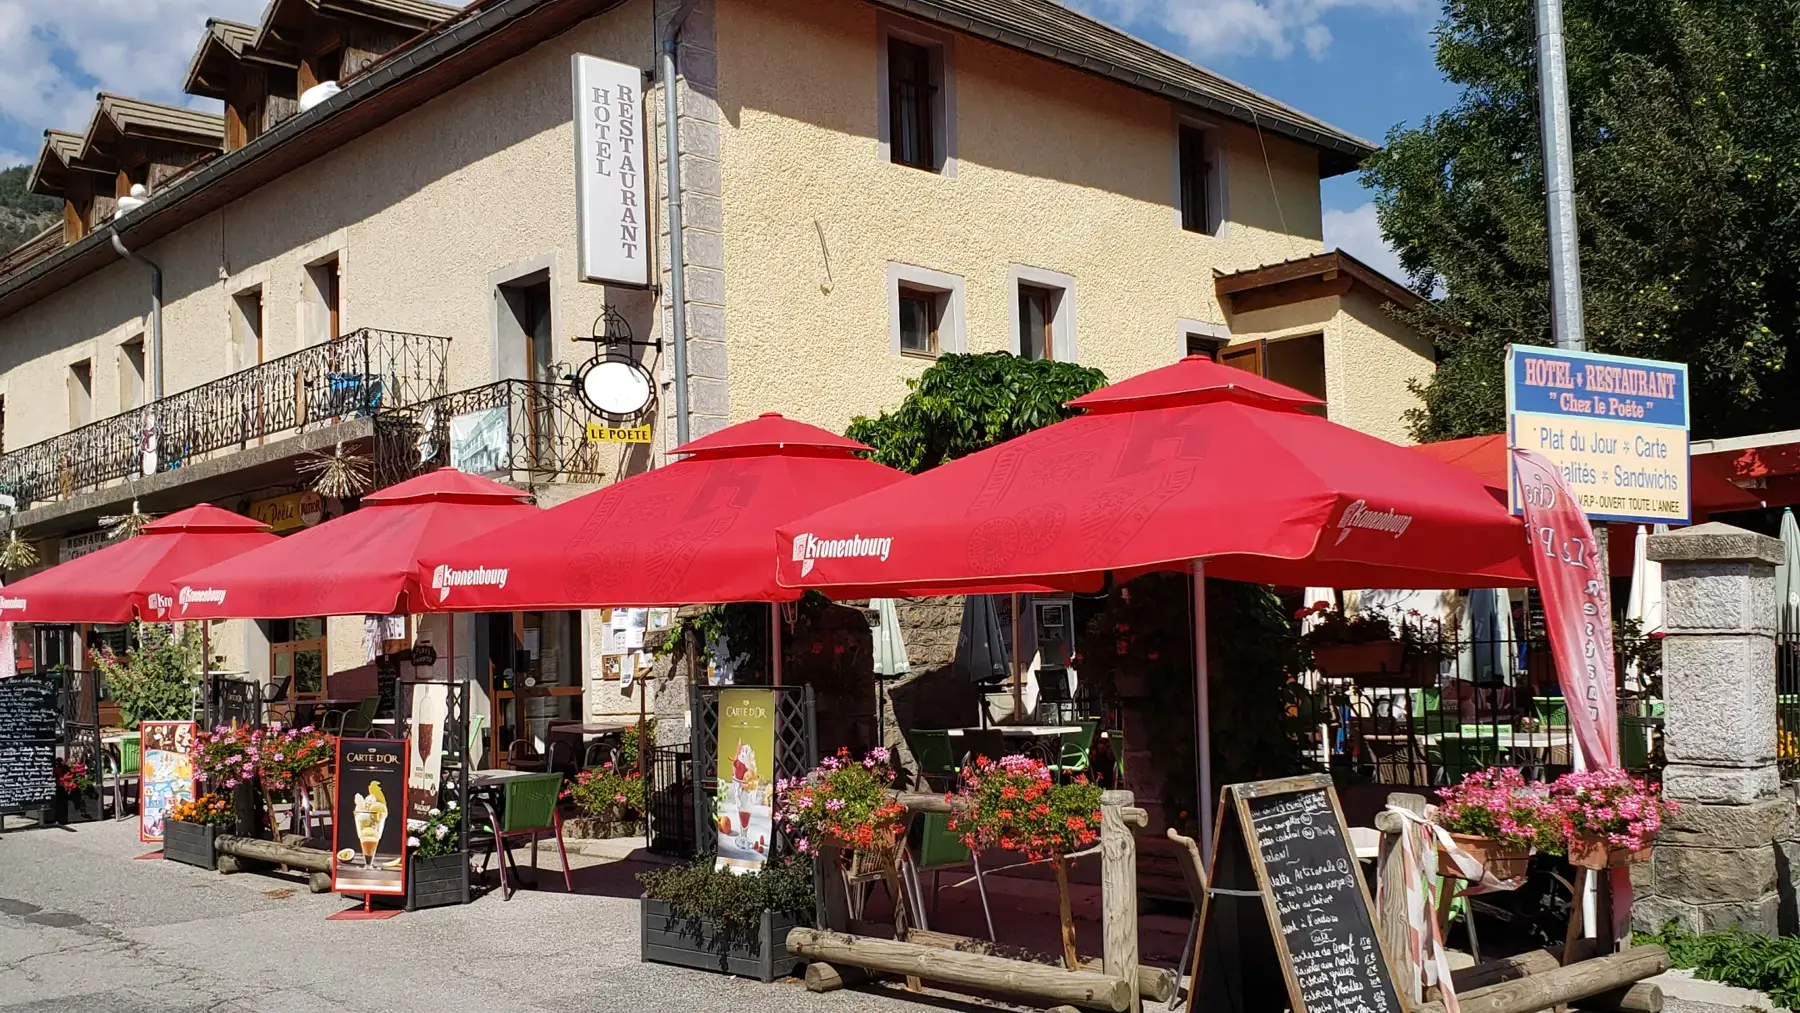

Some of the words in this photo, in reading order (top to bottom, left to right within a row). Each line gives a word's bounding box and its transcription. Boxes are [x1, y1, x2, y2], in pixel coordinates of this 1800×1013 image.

[591, 86, 611, 177] HOTEL
[617, 84, 638, 260] RESTAURANT
[1524, 358, 1575, 389] HOTEL
[1585, 364, 1677, 400] RESTAURANT
[1594, 396, 1605, 415] le
[591, 429, 605, 439] LE
[609, 430, 649, 440] POETE
[1540, 427, 1565, 451] Plat
[1570, 433, 1585, 451] du
[1591, 433, 1617, 454] Jour
[1635, 436, 1667, 459] Carte
[1557, 461, 1596, 485] ialités
[1614, 465, 1678, 490] Sandwichs
[1599, 495, 1625, 510] OUVERT
[1629, 497, 1650, 511] TOUTE
[1652, 499, 1679, 513] L'ANNEE
[1347, 500, 1412, 538] Kronenbourg
[67, 532, 110, 549] RESTAUR
[805, 533, 892, 562] Kronenbourg
[443, 564, 509, 590] Kronenbourg
[186, 587, 227, 604] Kronenbourg
[726, 706, 748, 717] CARTE
[347, 752, 375, 762] CARTE
[376, 753, 401, 764] D'OR
